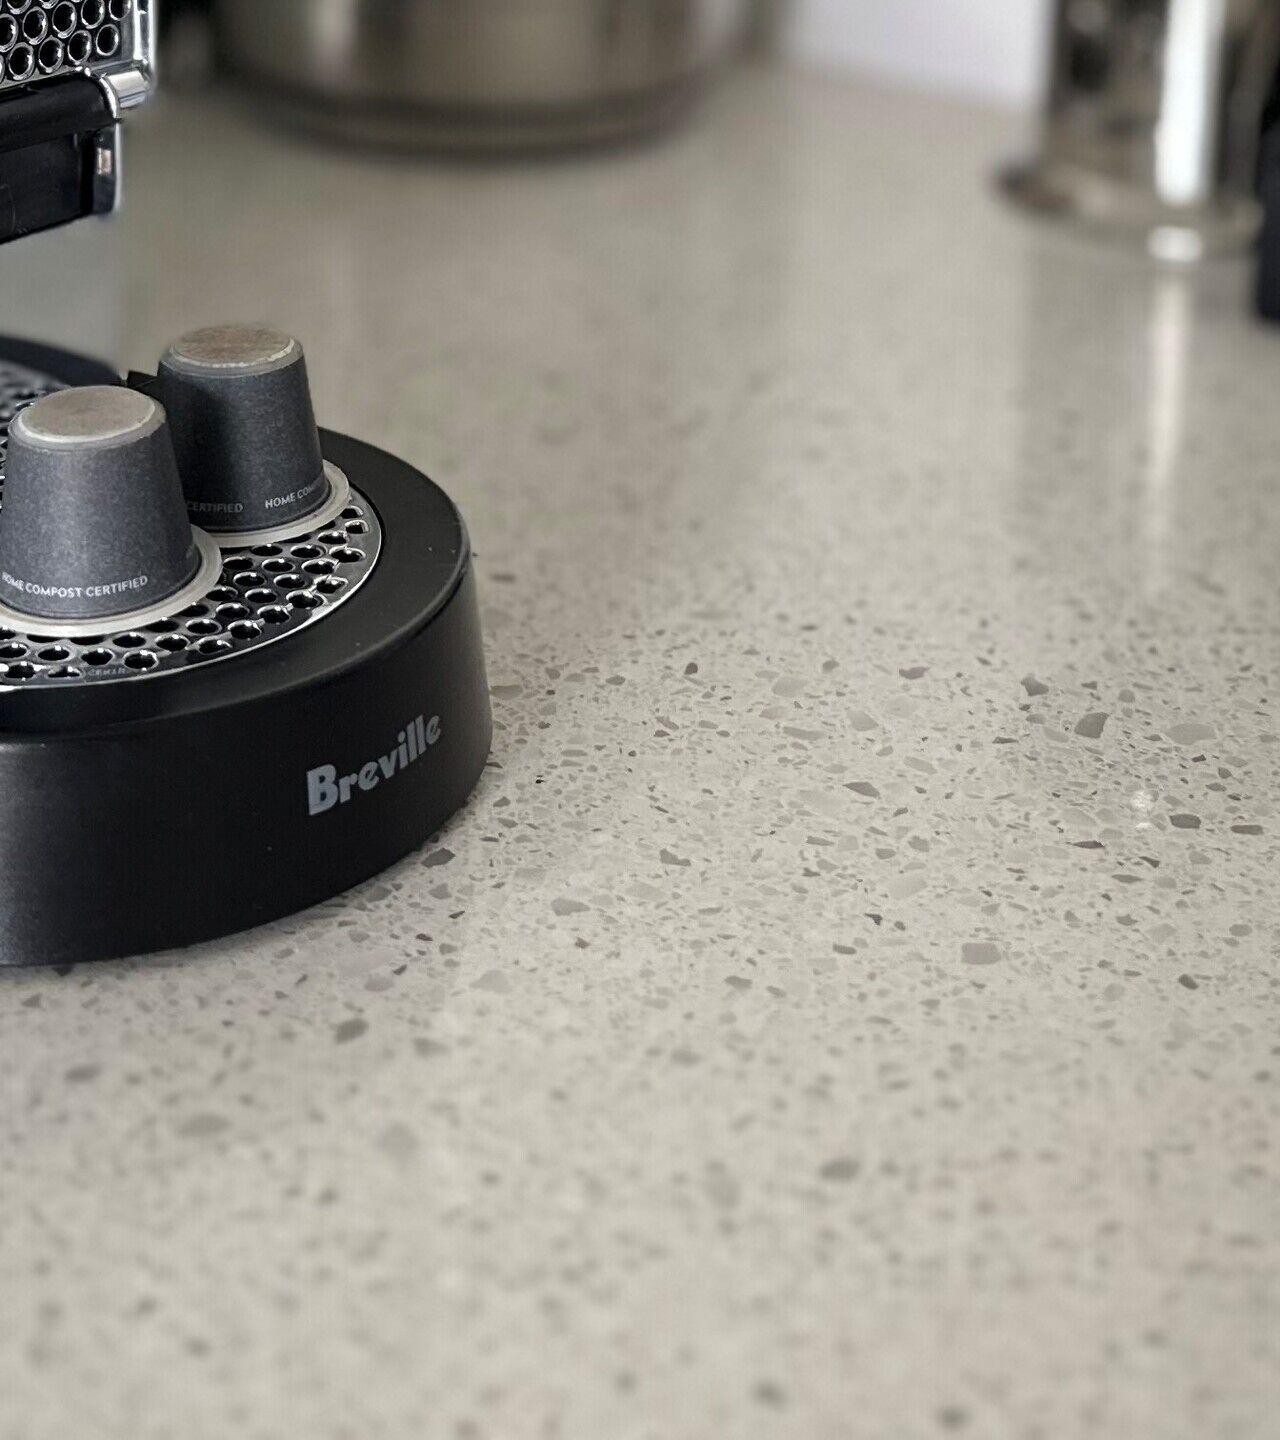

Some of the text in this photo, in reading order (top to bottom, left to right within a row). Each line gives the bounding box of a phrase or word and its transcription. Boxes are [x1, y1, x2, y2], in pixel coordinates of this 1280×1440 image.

[264, 491, 296, 510] HOME
[1, 571, 148, 599] HOME COMPOST CERTIFIED
[306, 713, 442, 817] Breville
